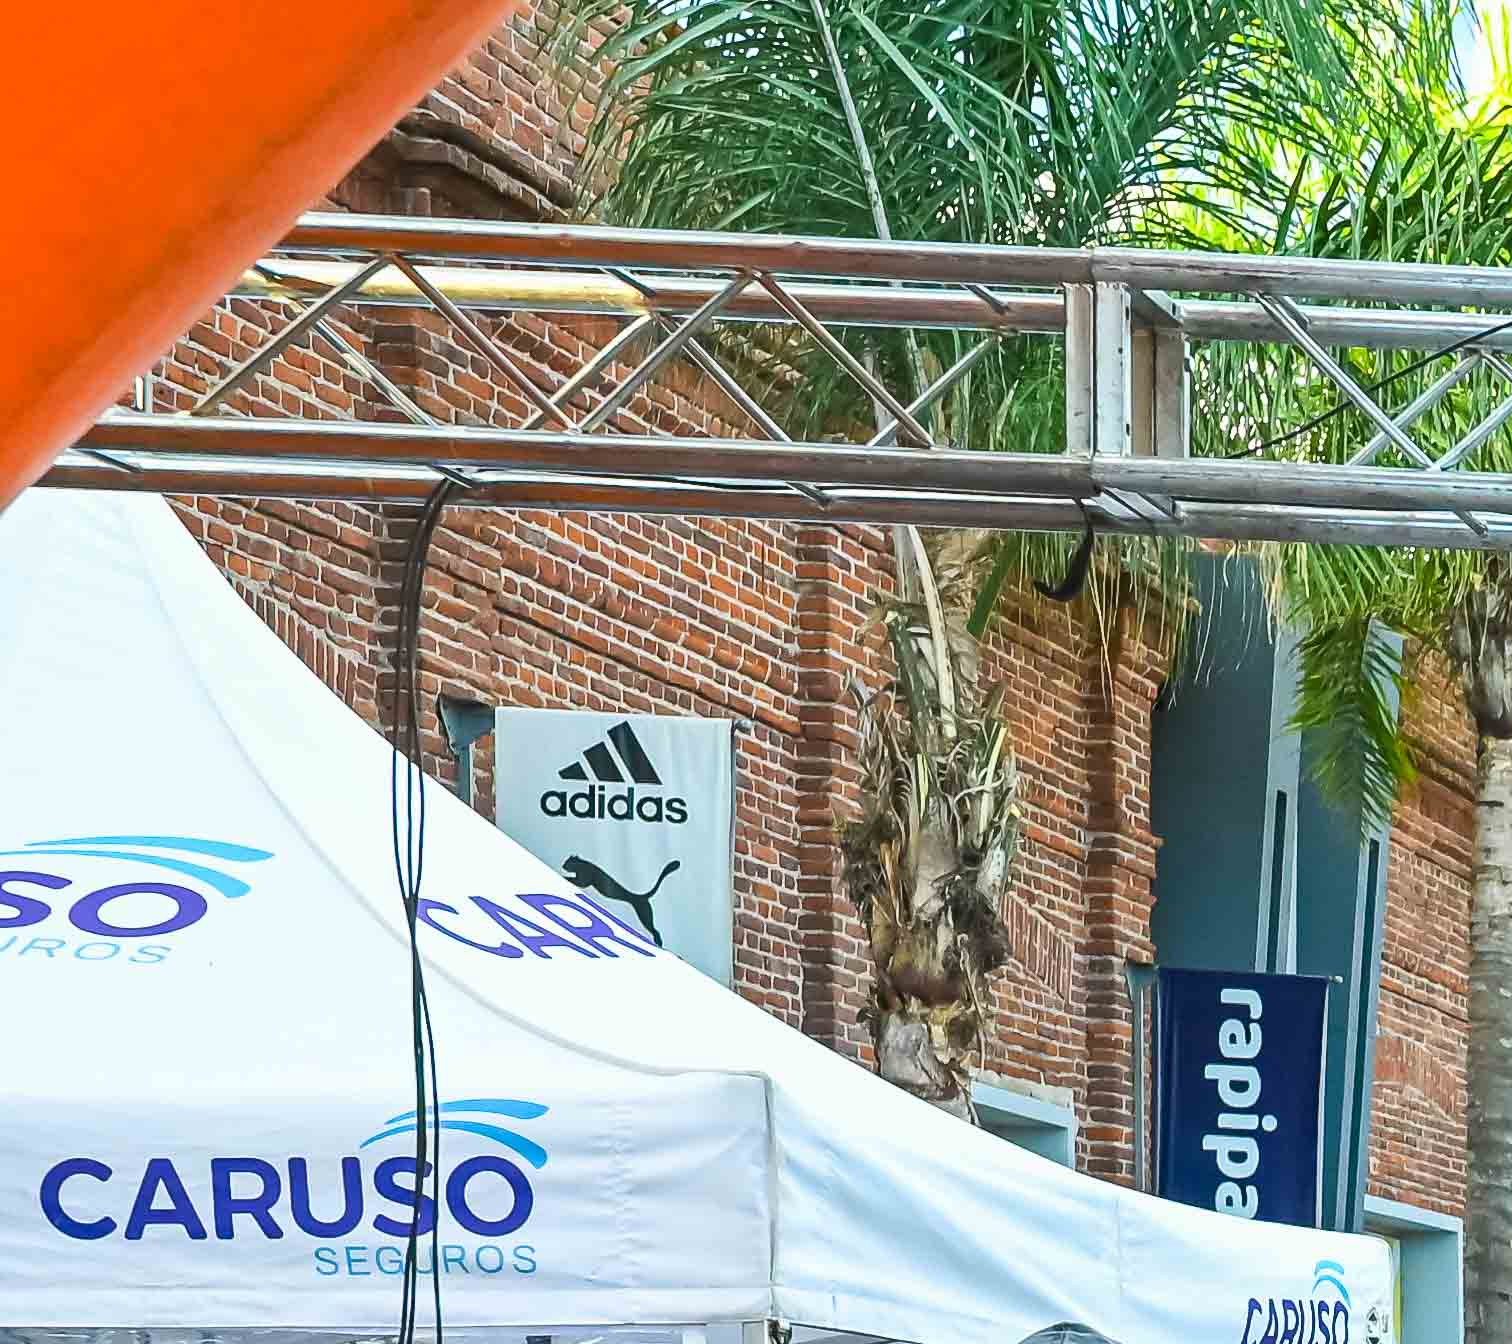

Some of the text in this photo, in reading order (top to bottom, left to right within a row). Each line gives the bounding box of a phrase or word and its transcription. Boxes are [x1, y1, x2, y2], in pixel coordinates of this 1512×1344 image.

[540, 784, 688, 824] adidas
[40, 1155, 536, 1241] CARUSO
[314, 1245, 538, 1277] SEGUROS
